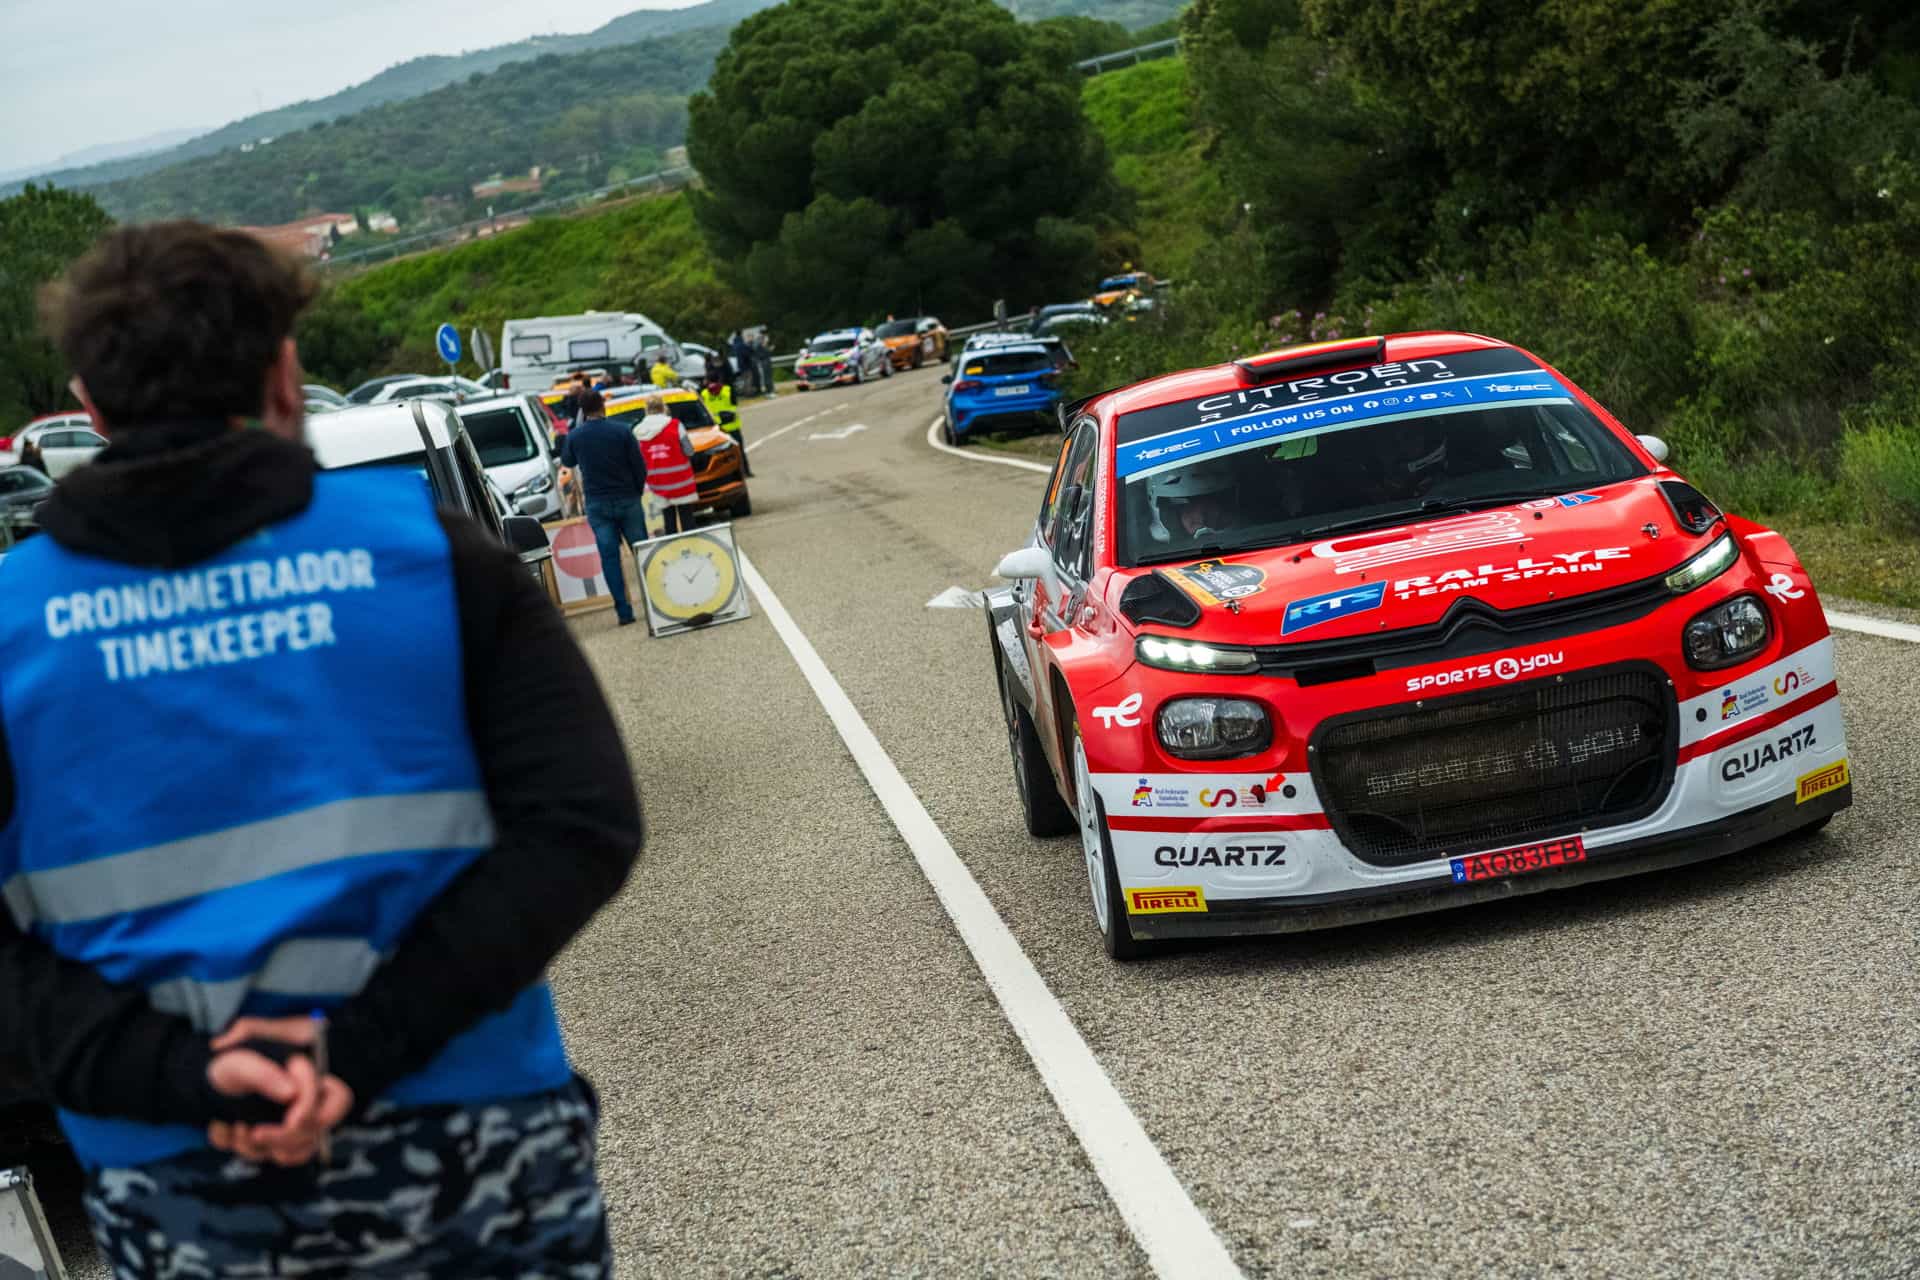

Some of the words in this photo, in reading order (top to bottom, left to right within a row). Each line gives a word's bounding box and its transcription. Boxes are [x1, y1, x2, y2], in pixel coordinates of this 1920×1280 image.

[1231, 414, 1298, 436] FOLLOW
[1303, 409, 1327, 421] US
[1330, 404, 1354, 415] ON
[1394, 547, 1631, 592] RALLYE
[1394, 577, 1489, 600] TEAM
[1502, 562, 1603, 582] SPAIN
[44, 548, 375, 639] CRONOMETRADOR
[1289, 588, 1380, 621] RTS
[98, 602, 337, 681] TIMEKEEPER
[1721, 723, 1817, 782] QUARTZ
[1800, 765, 1845, 798] PIRELLI
[1154, 845, 1287, 868] QUARTZ
[1470, 840, 1580, 879] AQ83FB
[1132, 891, 1199, 910] PIRELLI
